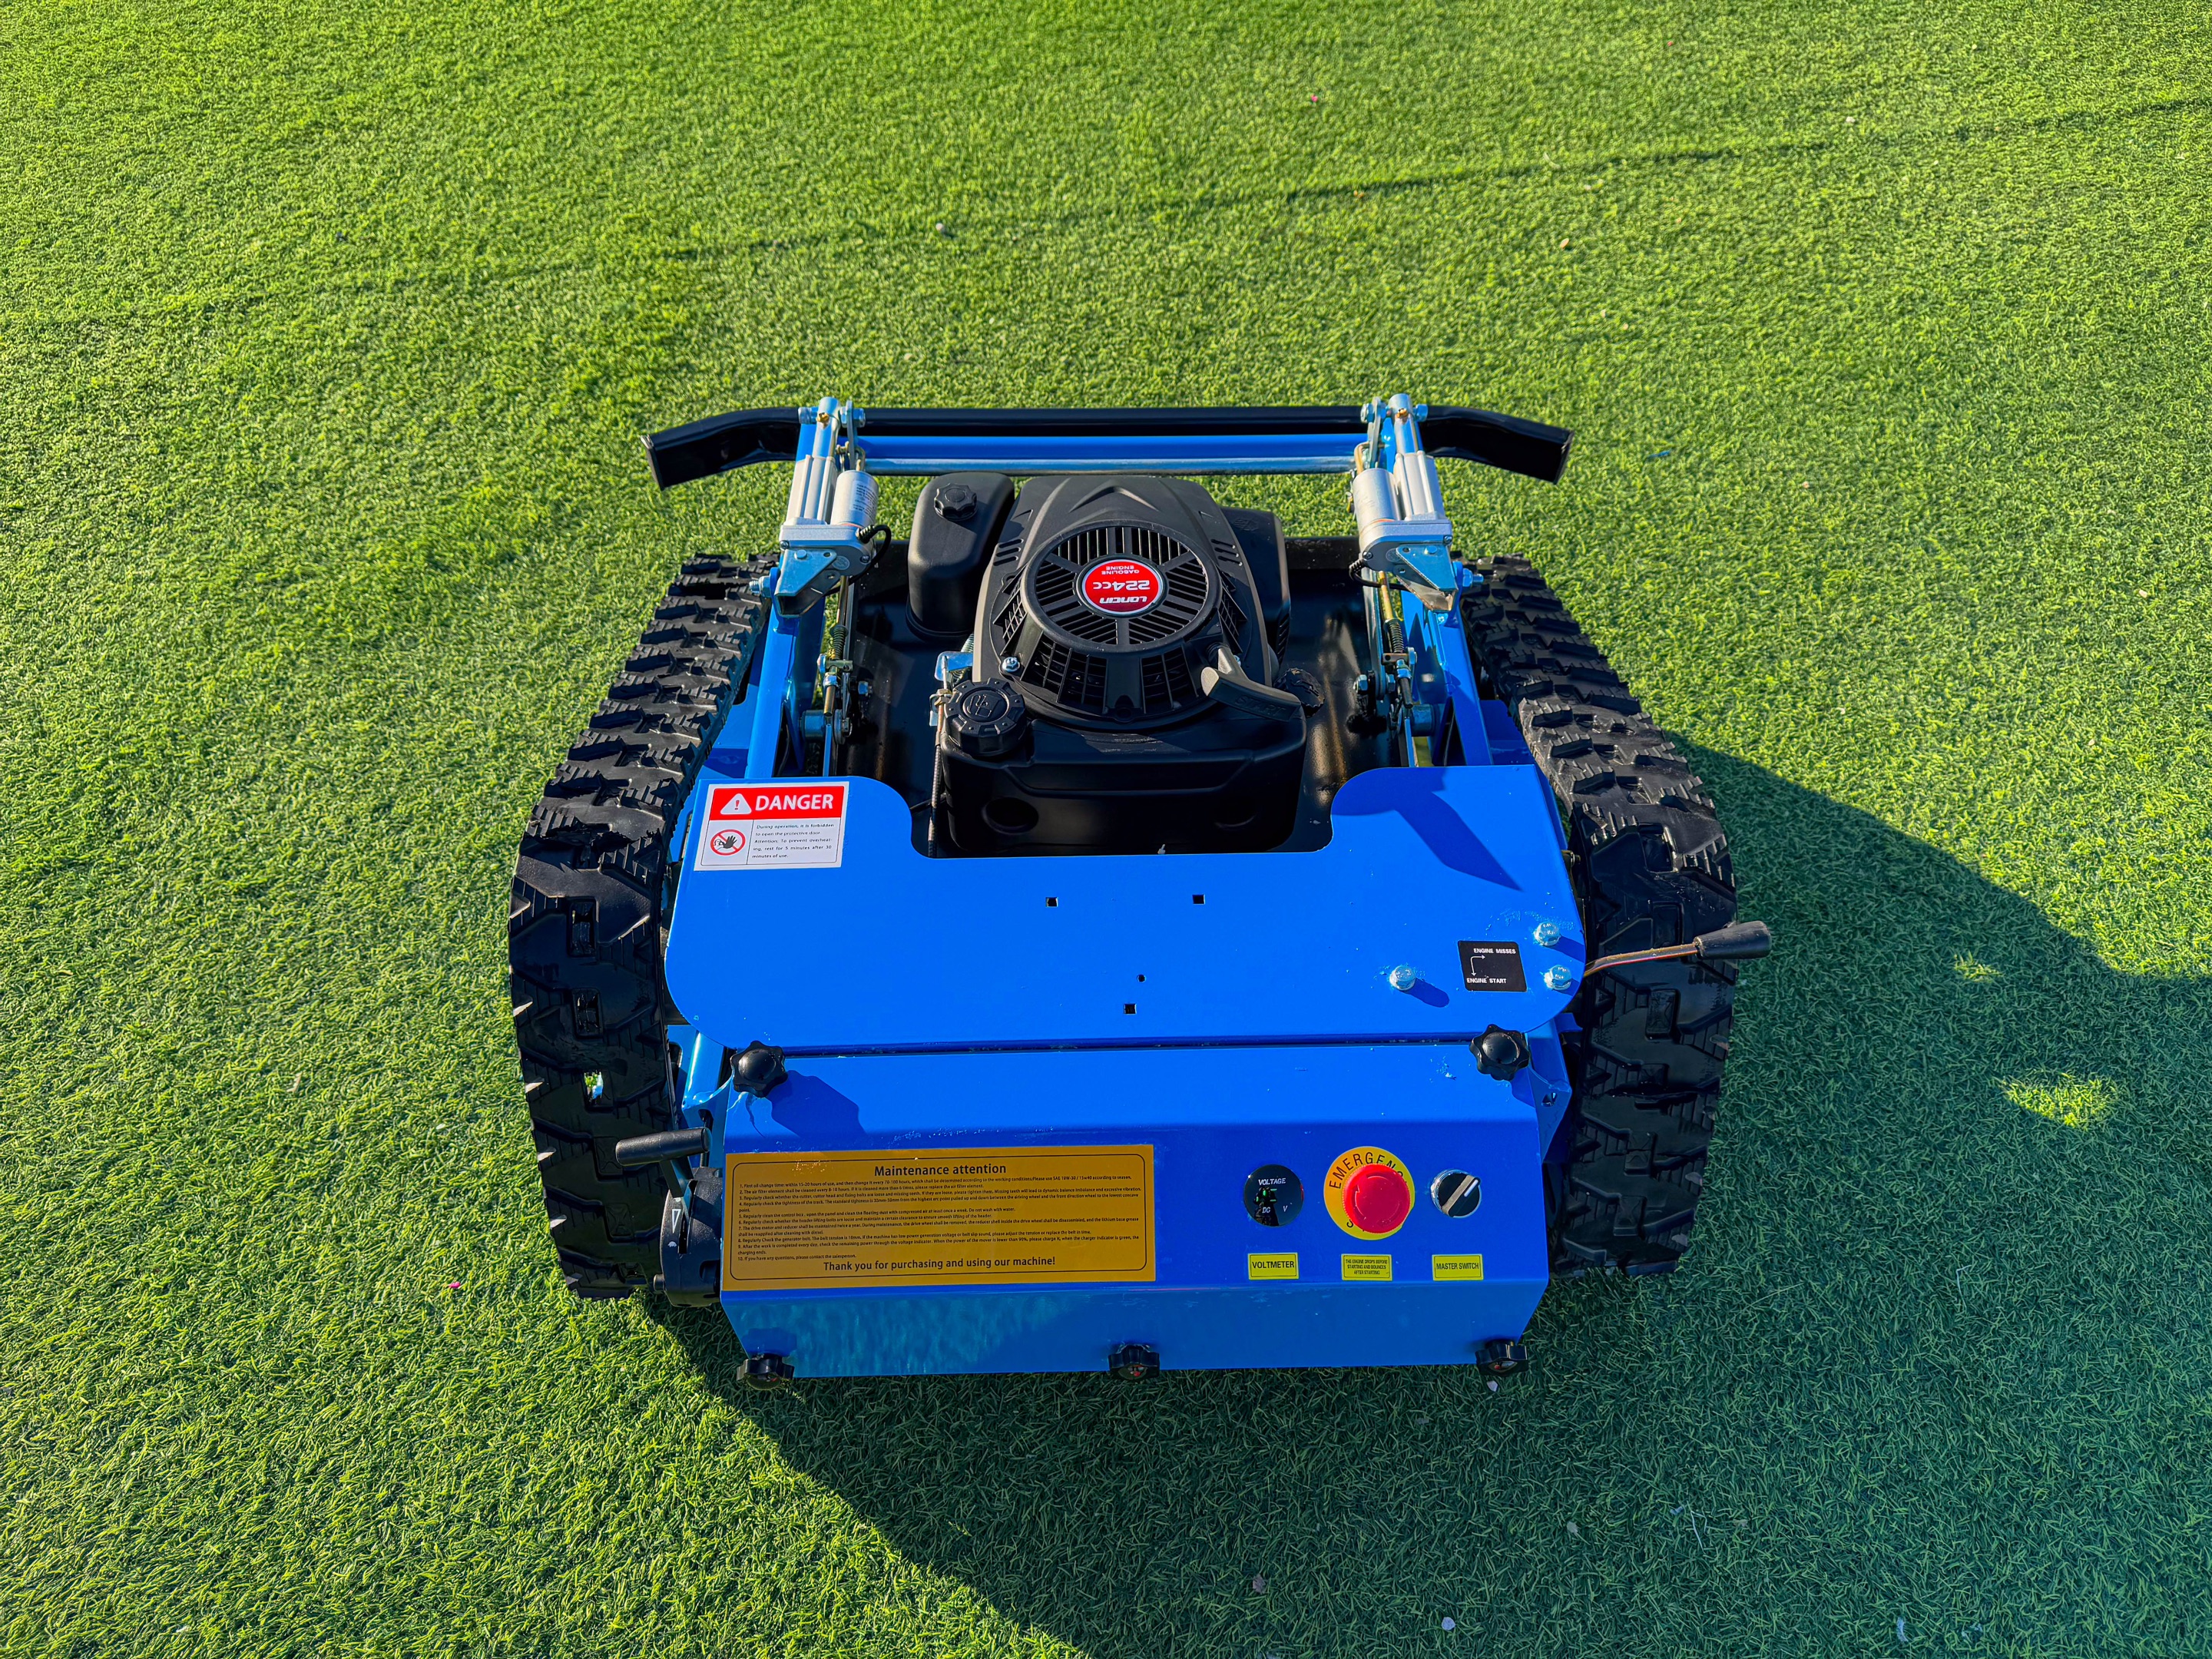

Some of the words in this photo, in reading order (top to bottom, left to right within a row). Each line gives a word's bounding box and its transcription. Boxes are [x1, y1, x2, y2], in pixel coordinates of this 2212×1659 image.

[1235, 695, 1287, 716] START
[755, 794, 834, 811] DANGER
[874, 1165, 949, 1176] Maintenance
[953, 1164, 1006, 1175] attention
[1329, 1151, 1408, 1189] EMERGEN
[824, 1262, 852, 1270] Thank
[855, 1264, 873, 1272] you
[875, 1261, 888, 1270] for
[891, 1259, 942, 1271] purchasing
[946, 1258, 963, 1267] and
[967, 1258, 991, 1269] using
[1013, 1256, 1055, 1265] machine!
